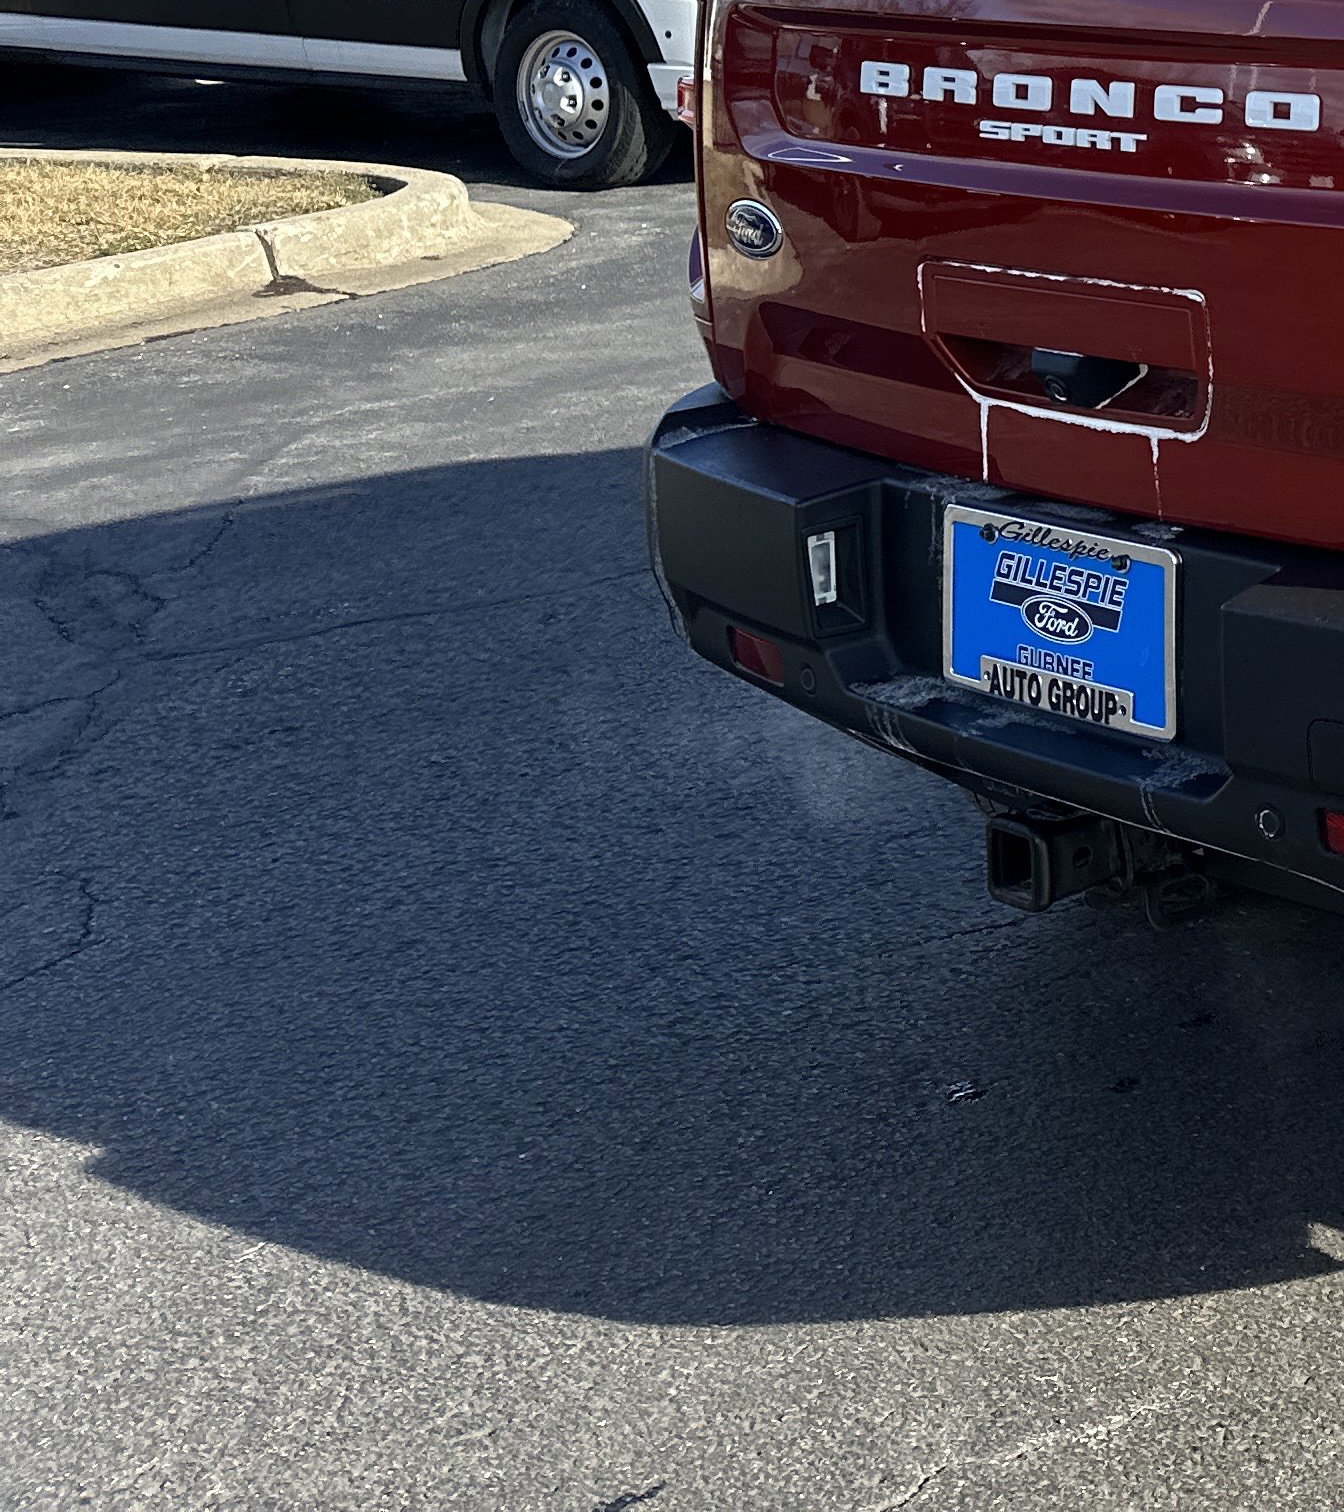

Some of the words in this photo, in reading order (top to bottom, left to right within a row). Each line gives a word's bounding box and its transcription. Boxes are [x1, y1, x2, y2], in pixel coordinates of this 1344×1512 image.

[860, 60, 1322, 132] BRONCO
[979, 120, 1148, 153] SPORT
[999, 520, 1110, 561] Gillespie
[995, 551, 1129, 608] GILLESPIE
[1034, 600, 1079, 638] Ford
[988, 664, 1042, 706] AUTO
[1048, 678, 1118, 725] GROUP
